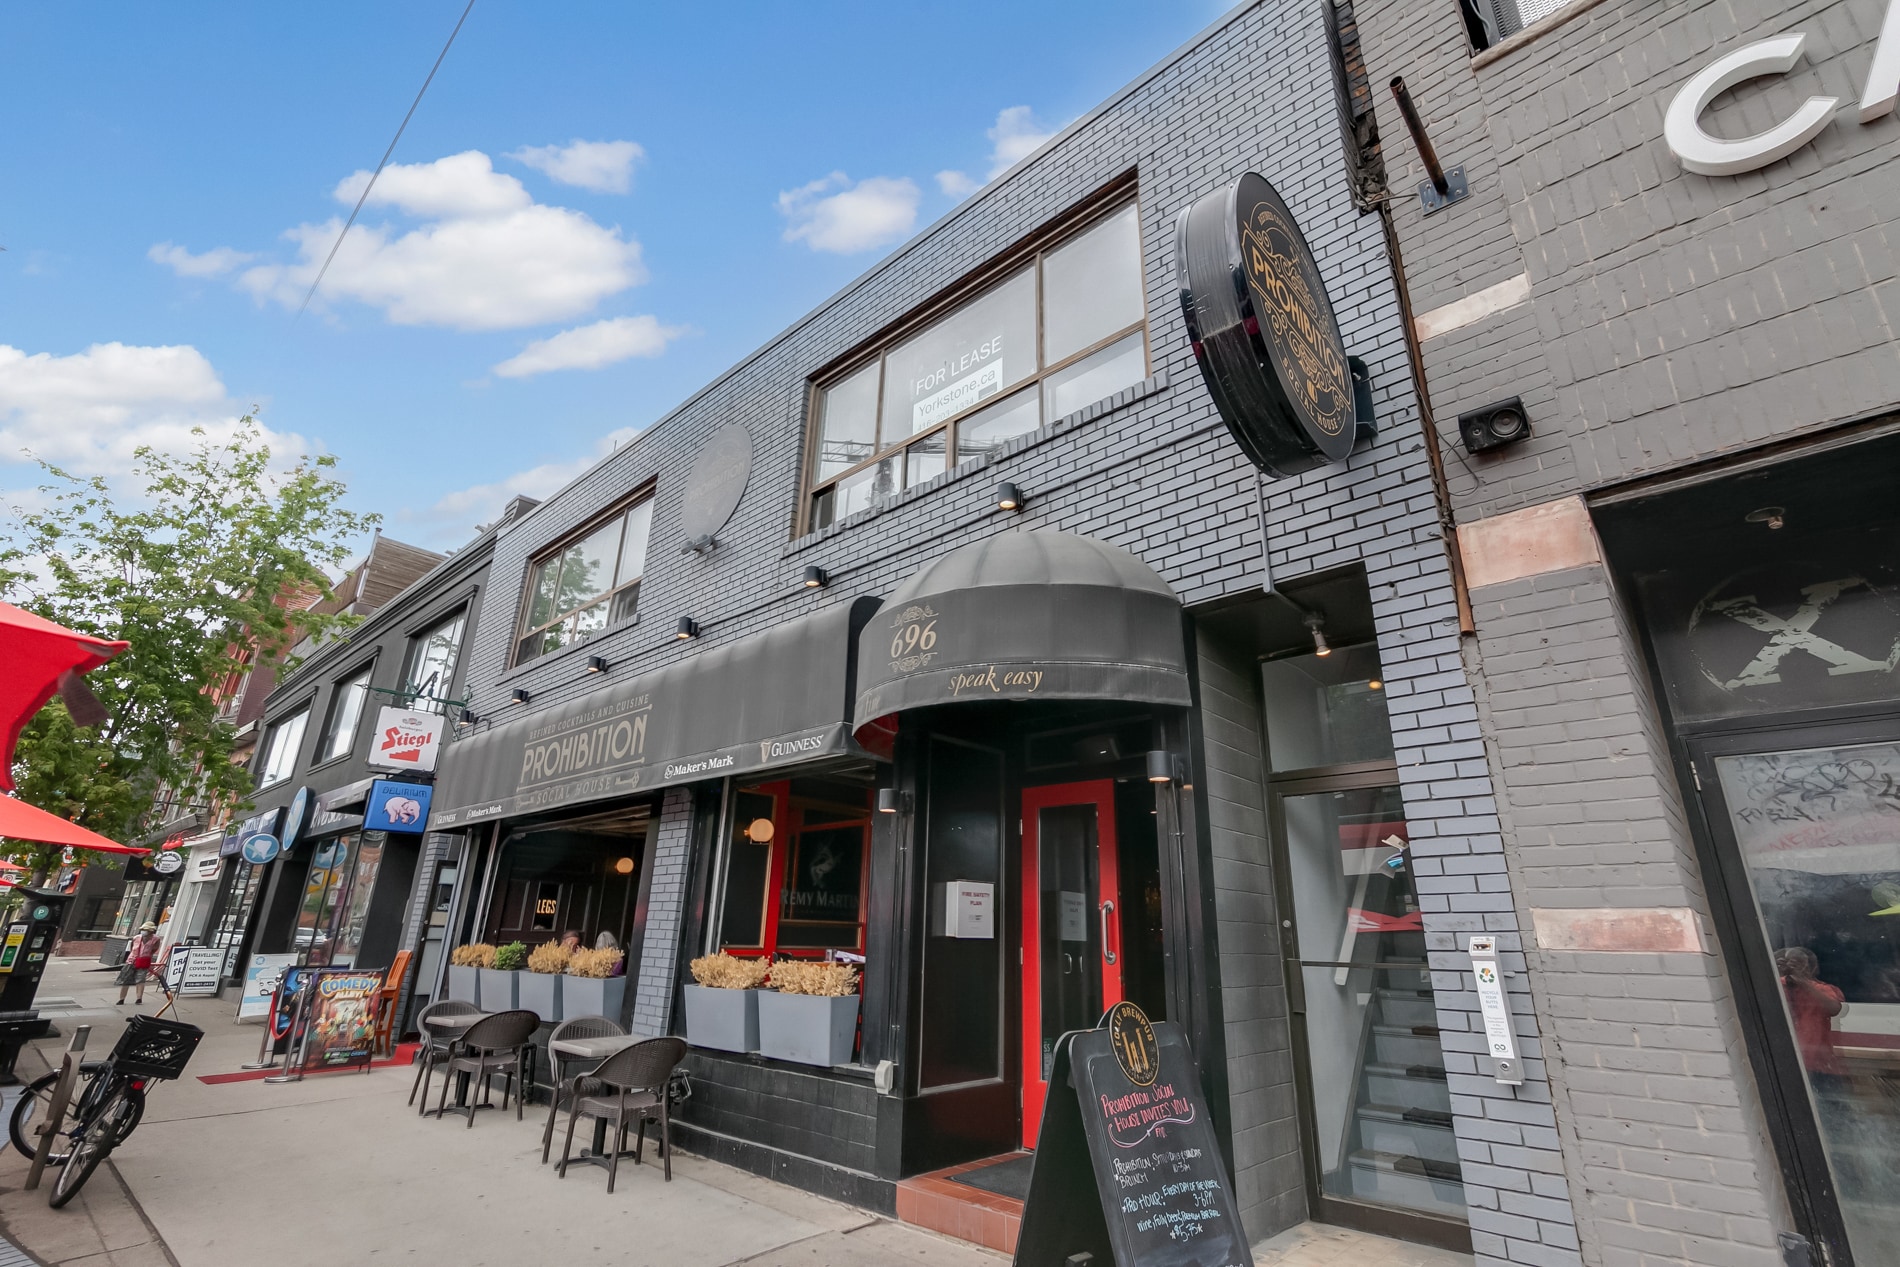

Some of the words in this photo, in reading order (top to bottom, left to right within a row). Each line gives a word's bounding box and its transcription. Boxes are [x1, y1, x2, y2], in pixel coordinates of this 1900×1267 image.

[1251, 246, 1347, 391] PROHIBITION
[916, 367, 946, 396] FOR
[951, 335, 1002, 377] LEASE
[919, 369, 996, 417] Yorkstone.ca
[1282, 357, 1315, 416] SOCIAL
[1316, 412, 1338, 430] HOUSE
[890, 619, 938, 659] 696
[948, 666, 1000, 697] speak
[1003, 670, 1043, 693] easy
[529, 724, 556, 740] REFINED
[557, 710, 596, 731] COCKTAILS
[597, 705, 614, 719] AND
[615, 693, 650, 713] CUISINE
[381, 726, 433, 751] Stiegl
[520, 713, 648, 784] PROHIBITION
[771, 734, 824, 757] GUINNESS
[673, 761, 707, 777] Maker's
[707, 755, 734, 770] Mark
[382, 786, 428, 799] DELIRIUM
[535, 784, 571, 805] SOCIAL
[575, 774, 611, 797] HOUSE
[536, 899, 557, 914] LEGS
[321, 977, 381, 995] COMEDY
[1121, 1006, 1154, 1042] BREWPUB
[1101, 1092, 1150, 1118] PROHIBITION
[1114, 1112, 1141, 1132] HOUSE
[1140, 1101, 1172, 1124] INVITES
[1119, 1172, 1149, 1189] BRUNCH
